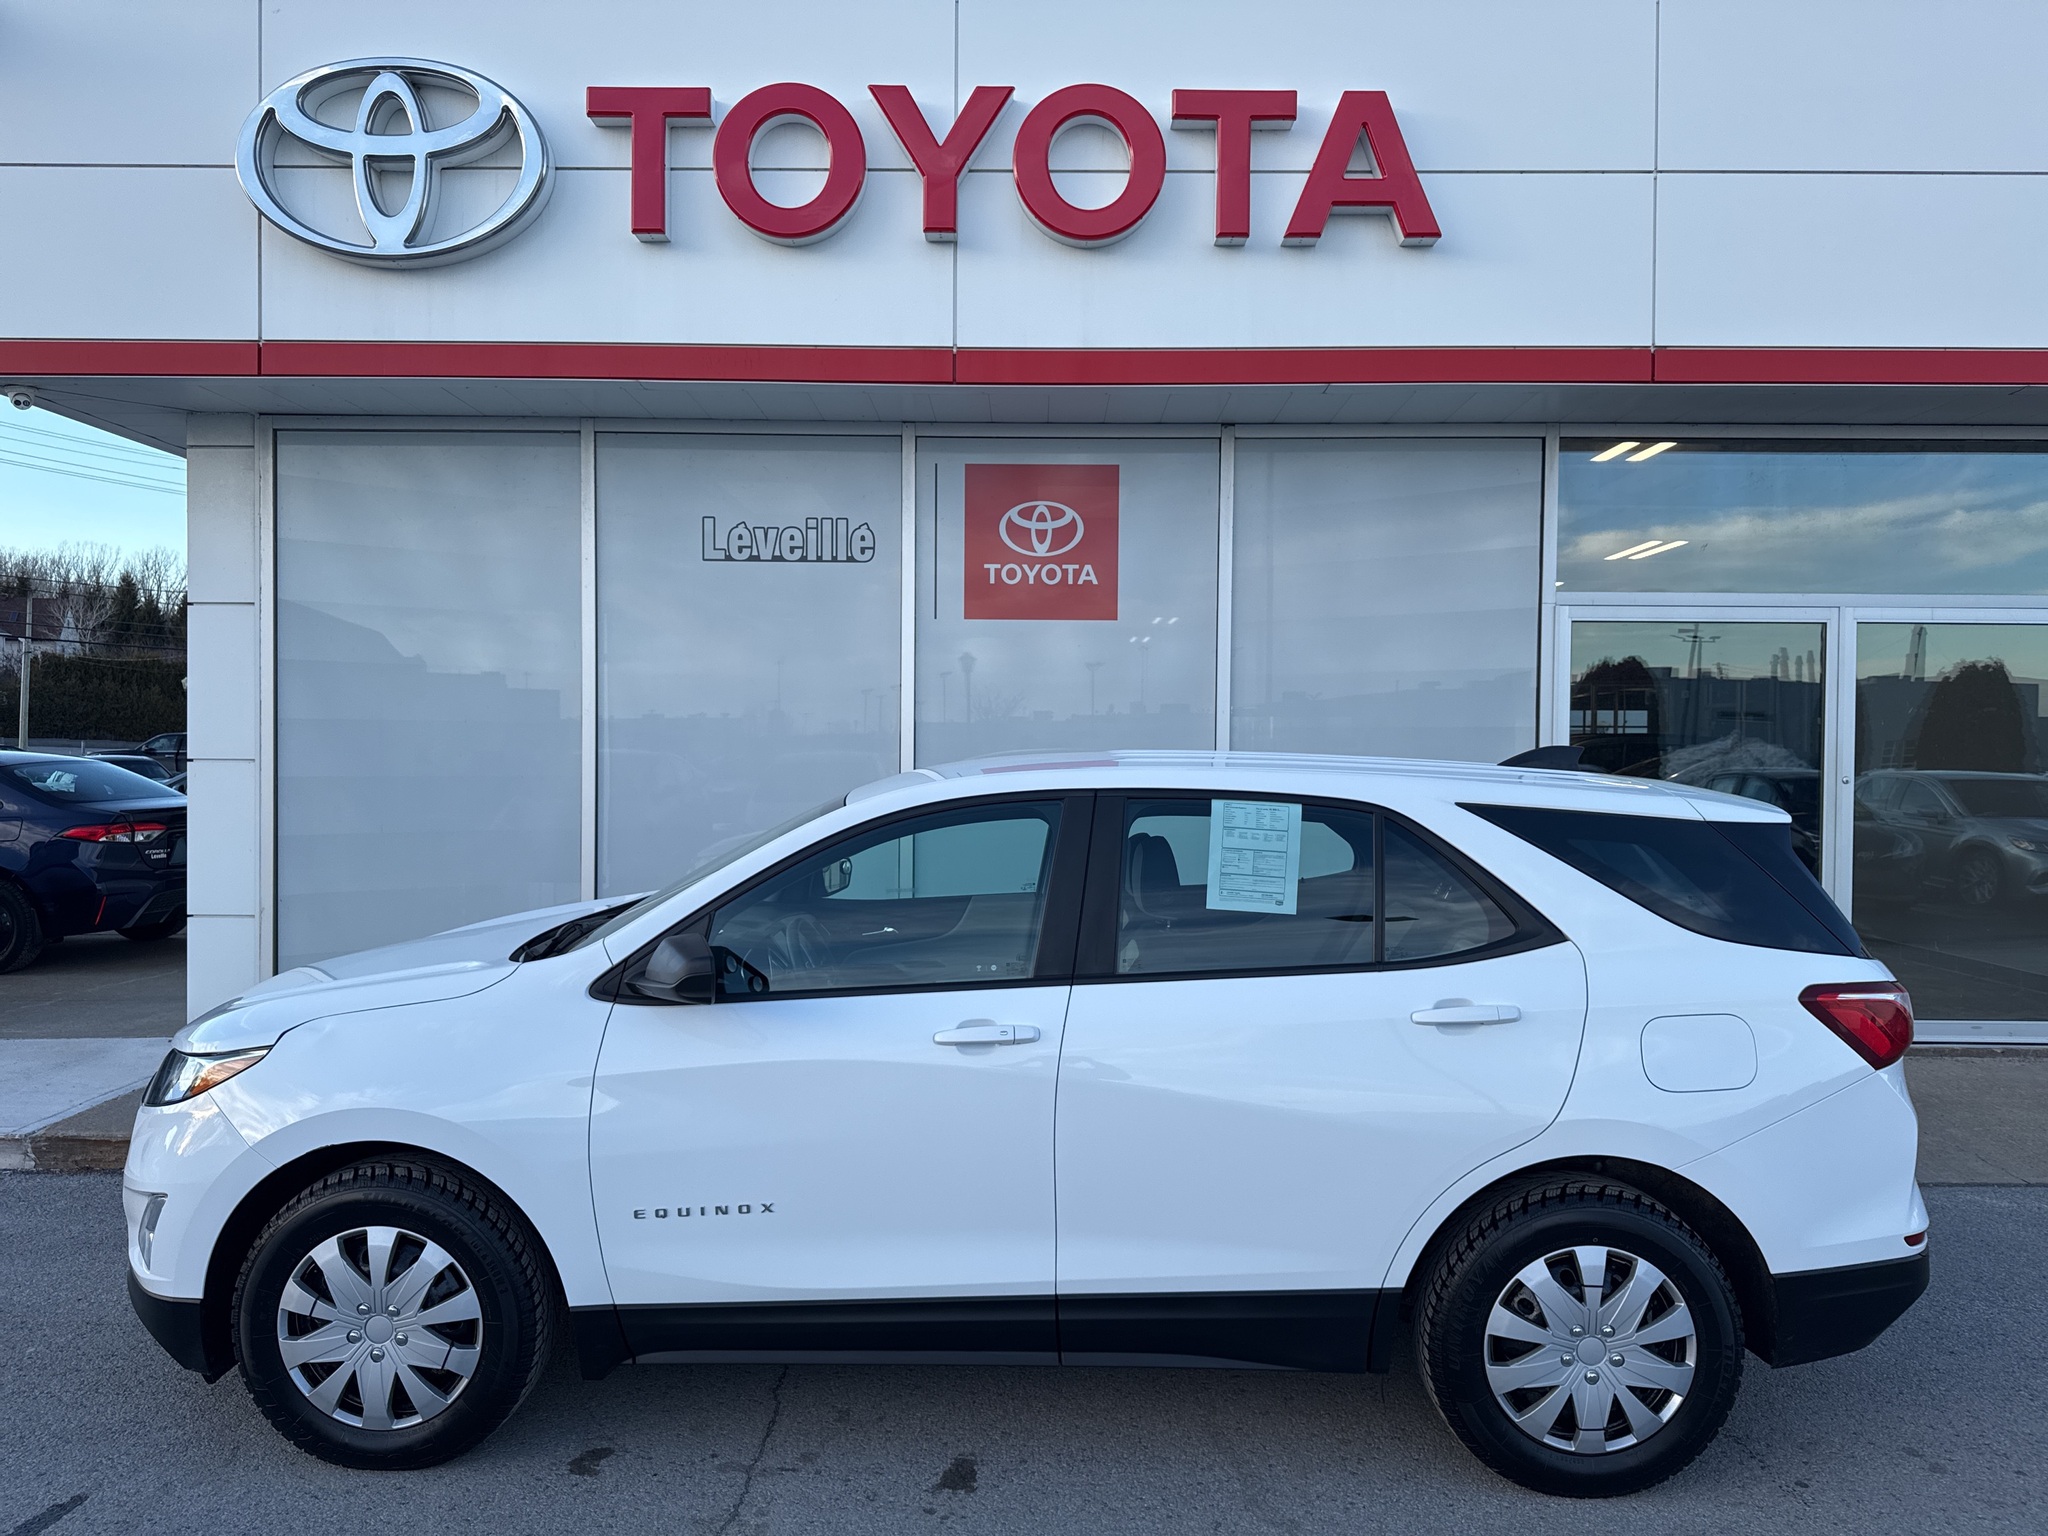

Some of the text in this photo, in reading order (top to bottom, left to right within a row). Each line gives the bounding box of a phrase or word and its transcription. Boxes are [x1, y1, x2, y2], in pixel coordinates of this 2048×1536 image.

[586, 83, 1442, 246] TOYOTA
[702, 516, 876, 562] Léveillé
[983, 563, 1098, 585] TOYOTA
[633, 1202, 774, 1219] EQUINOX
